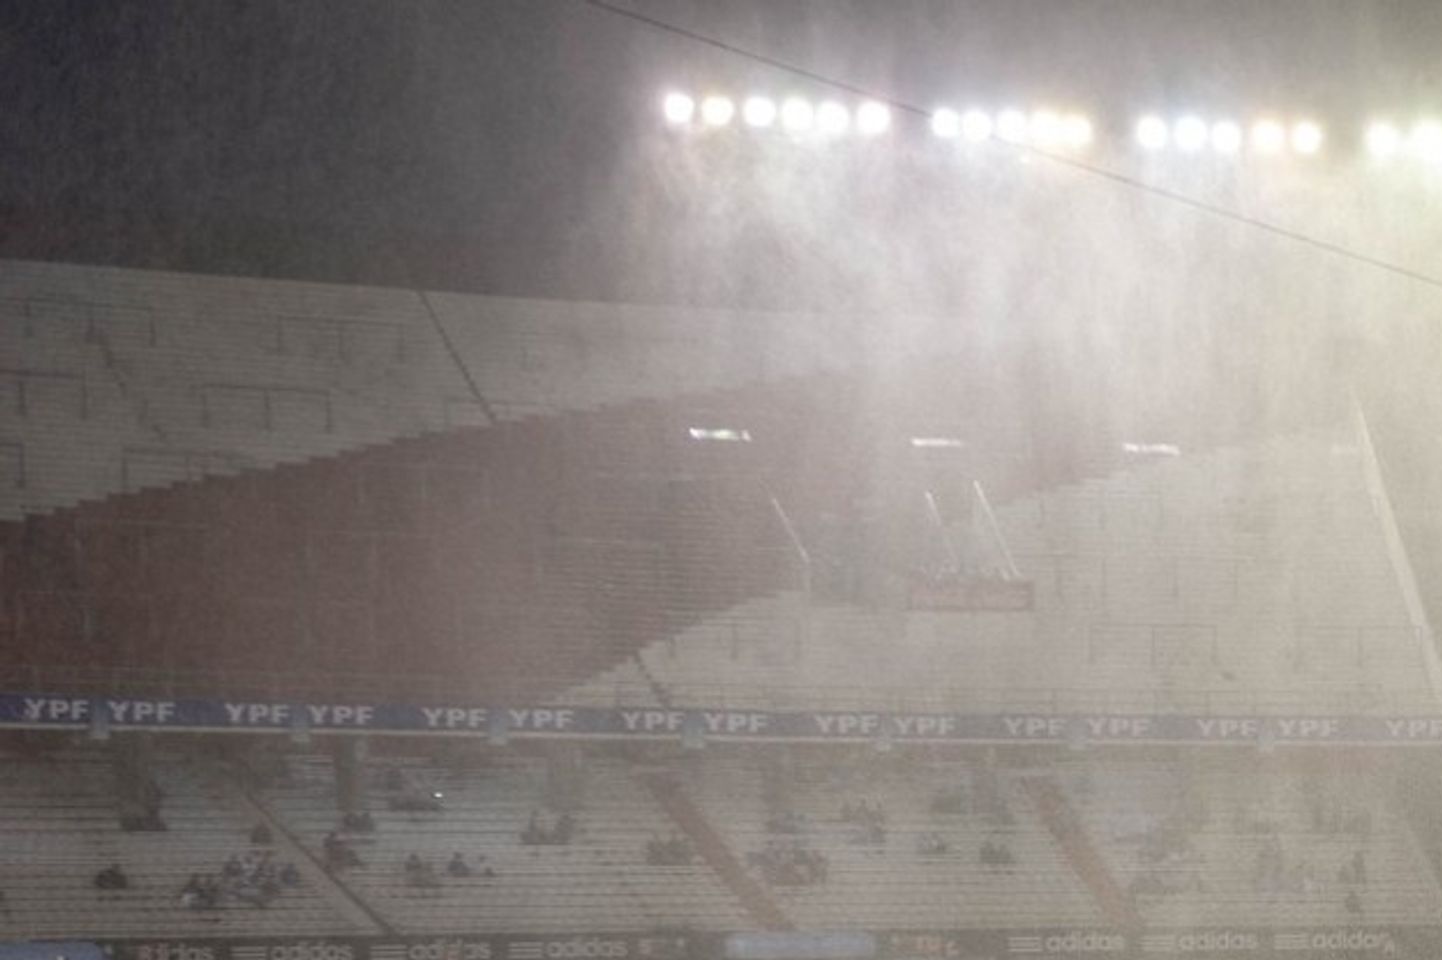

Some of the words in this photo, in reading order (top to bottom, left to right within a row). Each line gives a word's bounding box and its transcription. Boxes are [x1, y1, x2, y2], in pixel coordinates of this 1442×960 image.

[24, 699, 89, 720] YPF
[107, 701, 176, 721] YPF
[224, 703, 290, 724] YPF
[308, 704, 374, 724] YPF
[421, 708, 487, 728] YPF
[509, 709, 574, 729] YPF
[621, 711, 684, 730] YPF
[704, 712, 768, 732] YPF
[814, 715, 878, 734] YPF
[895, 716, 955, 735] YPF
[1004, 717, 1066, 736] YPF
[1086, 717, 1150, 736] YPF
[1197, 718, 1258, 737] YPF
[1278, 719, 1338, 737] YPF
[547, 937, 629, 958] adidas
[1178, 930, 1258, 951] adidas
[1311, 929, 1391, 951] adida
